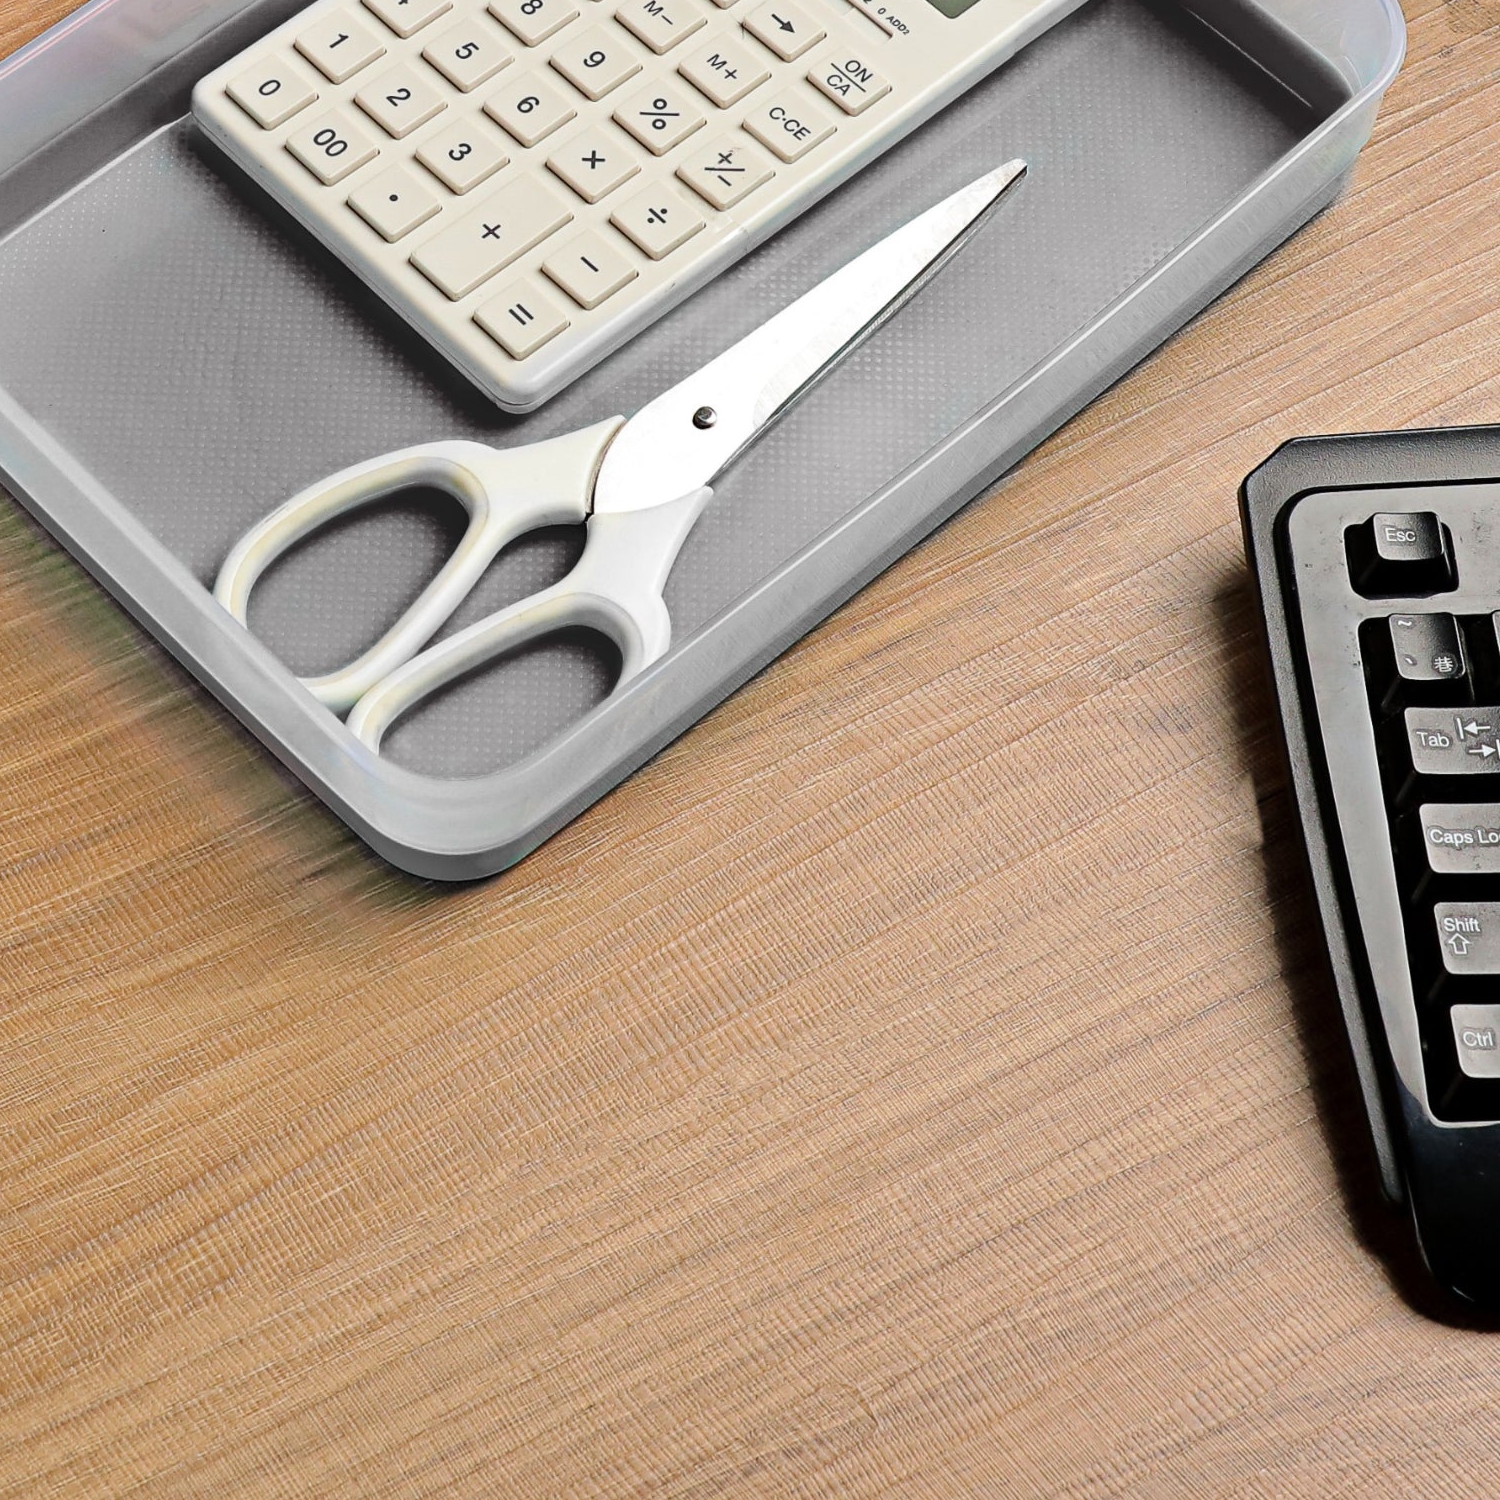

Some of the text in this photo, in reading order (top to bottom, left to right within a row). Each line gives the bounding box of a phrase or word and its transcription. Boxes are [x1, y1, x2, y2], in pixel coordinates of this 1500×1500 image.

[329, 33, 350, 49] 1
[455, 42, 480, 60] 5
[583, 51, 606, 68] 9
[845, 59, 874, 83] ON
[258, 79, 282, 97] 0
[826, 74, 851, 96] CA
[386, 87, 412, 107] 2
[516, 96, 540, 114] 6
[313, 128, 348, 157] 00
[448, 143, 472, 162] 3
[1384, 527, 1416, 543] Esc
[1416, 731, 1450, 748] Tab
[1429, 828, 1474, 847] Caps
[1443, 917, 1481, 933] Shift
[1462, 1031, 1494, 1047] Ctrl
